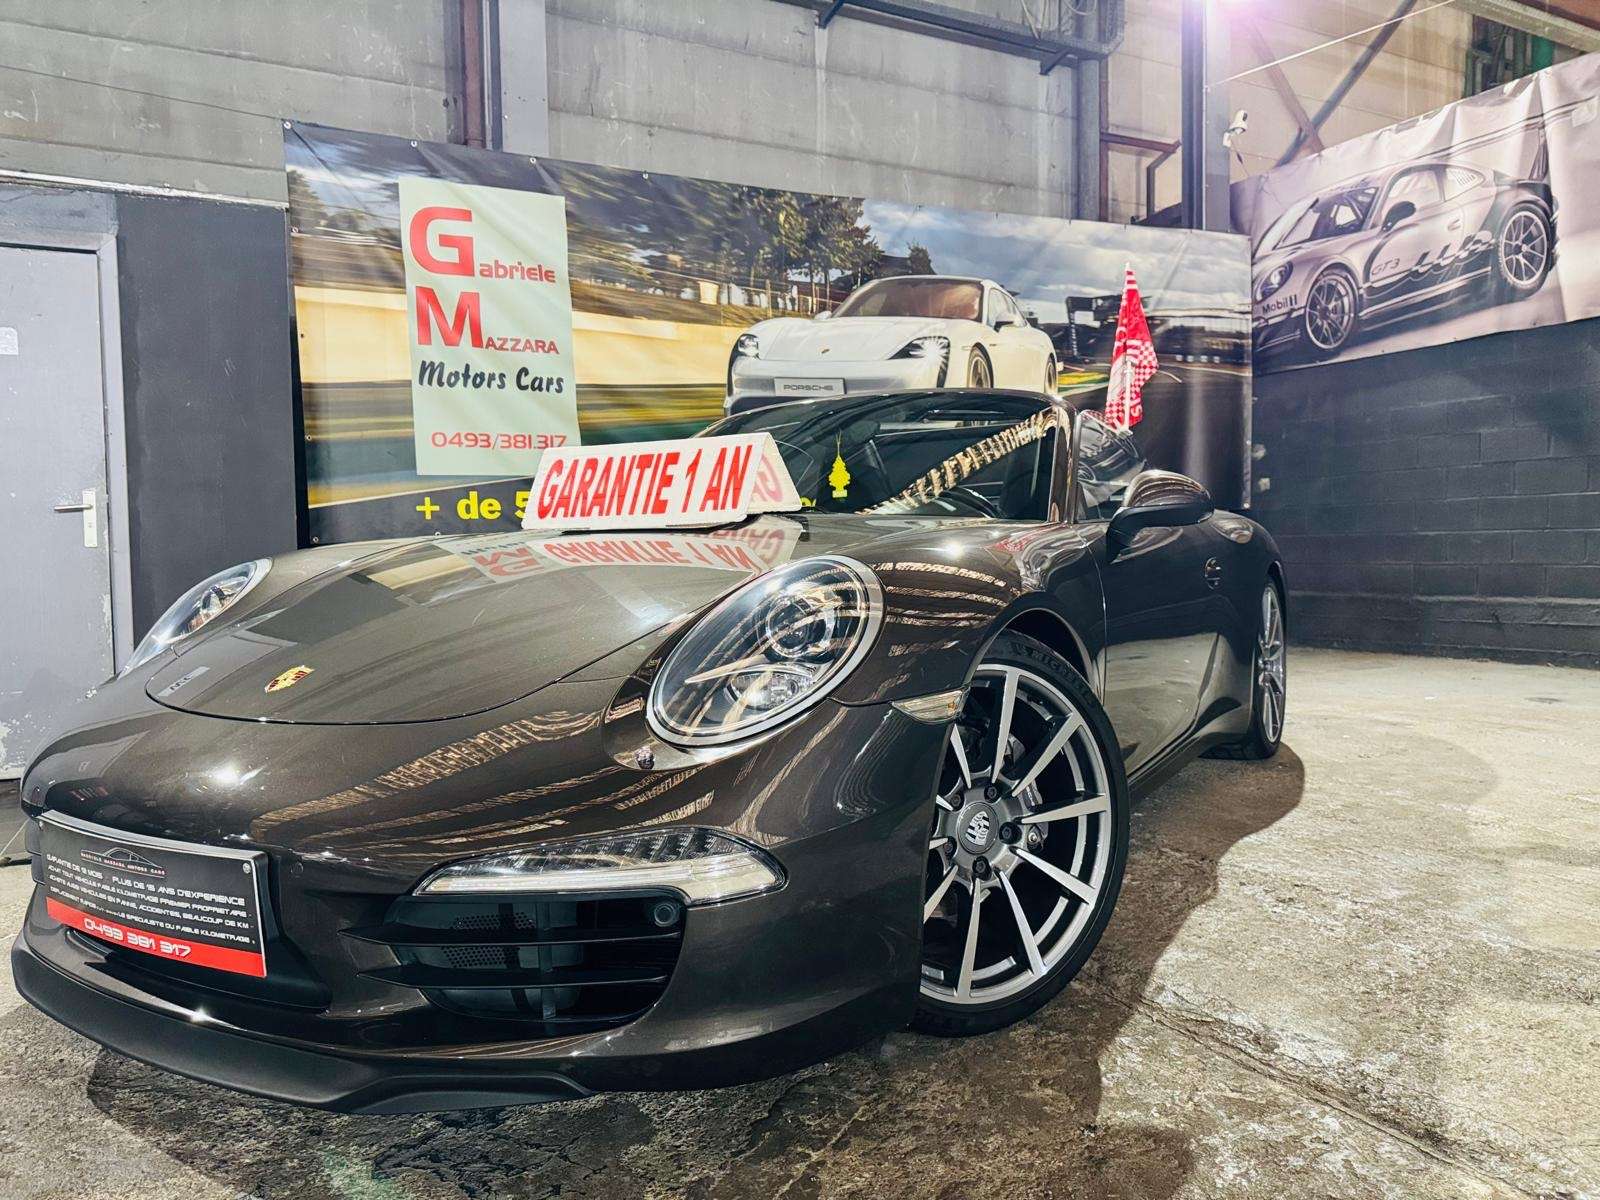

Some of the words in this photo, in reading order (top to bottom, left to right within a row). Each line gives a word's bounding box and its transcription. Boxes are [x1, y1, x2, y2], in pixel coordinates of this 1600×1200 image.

[409, 206, 556, 283] Gabriele
[415, 285, 560, 355] MAZZARA
[1262, 297, 1288, 313] Mobil
[418, 360, 506, 390] Motors
[516, 366, 564, 394] Cars
[537, 451, 680, 520] GARANTIE
[681, 448, 703, 513] 1
[699, 444, 753, 513] AN
[456, 490, 502, 520] de
[112, 876, 132, 887] PLUS
[133, 881, 145, 890] DE
[158, 886, 175, 896] ANS
[177, 888, 245, 906] D'EXPERIENCE
[83, 918, 124, 941] 0493
[126, 932, 156, 950] 381
[160, 940, 191, 957] 317
[224, 919, 236, 927] DE
